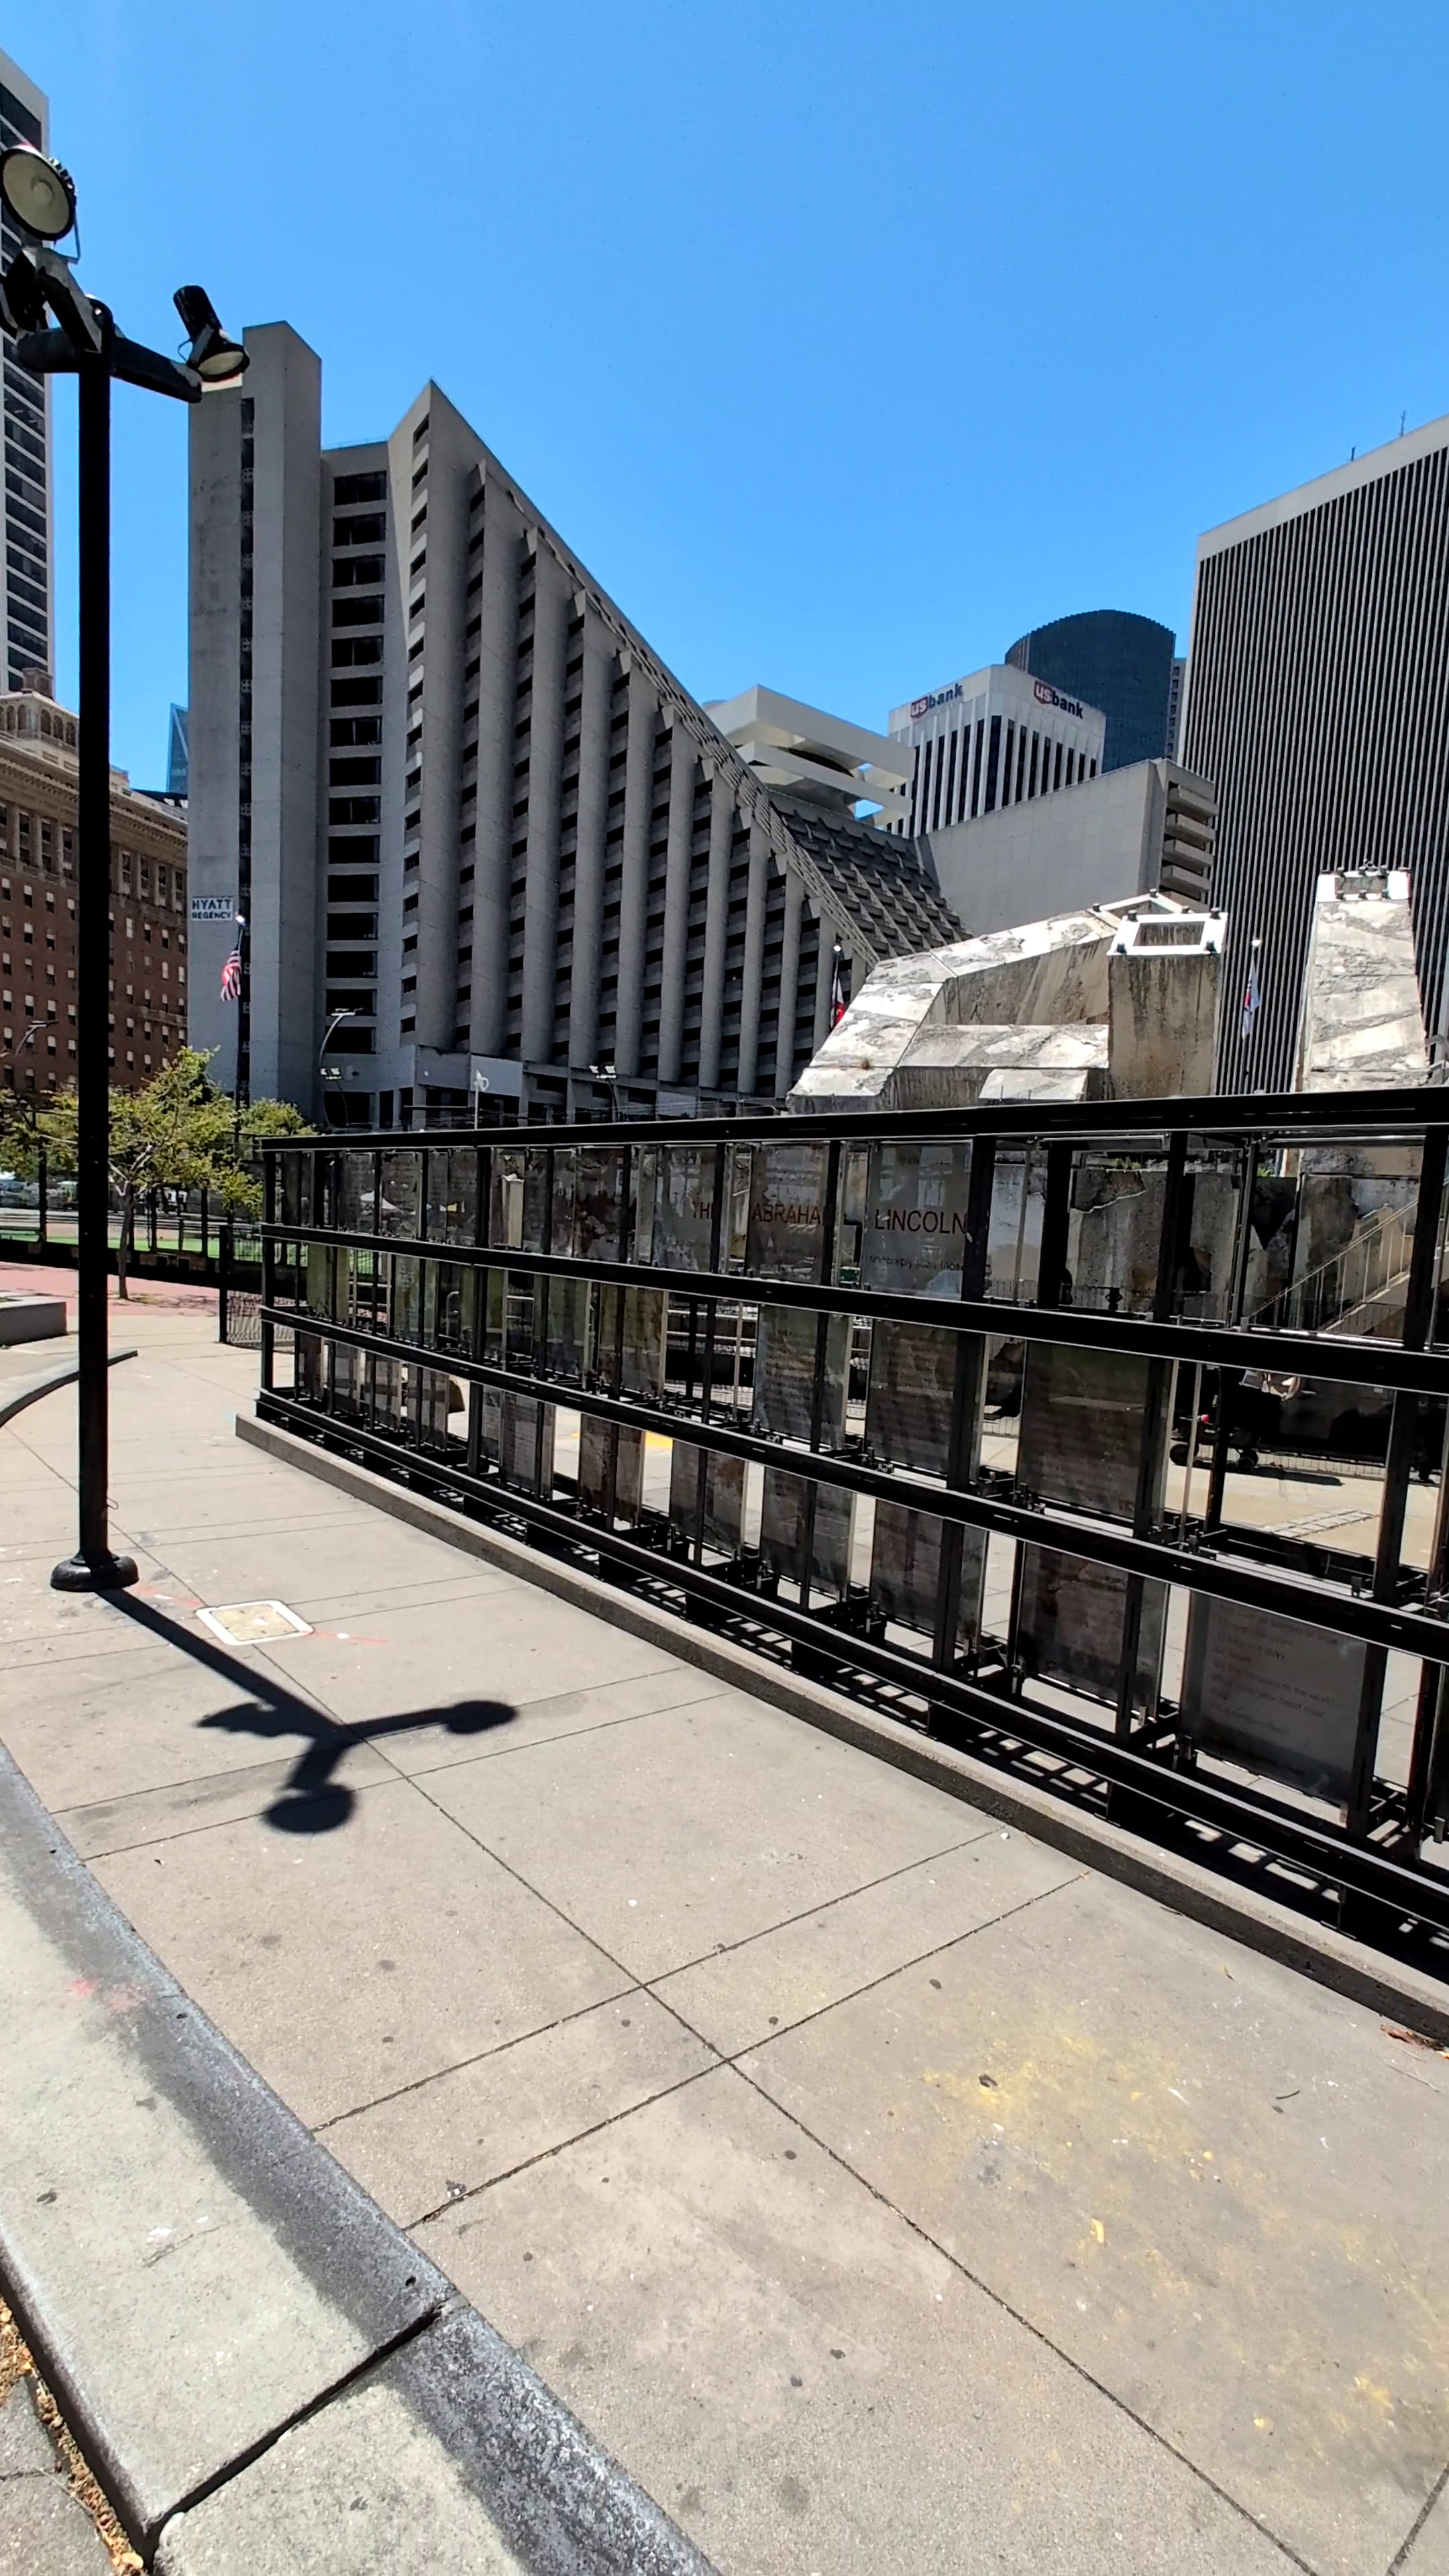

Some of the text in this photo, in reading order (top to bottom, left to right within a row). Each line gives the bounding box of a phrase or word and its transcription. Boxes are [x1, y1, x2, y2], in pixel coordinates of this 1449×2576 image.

[192, 899, 231, 910] HYATT
[192, 911, 231, 919] REGENCY
[752, 1203, 825, 1226] ABRAHA
[875, 1209, 967, 1234] LINCOLN
